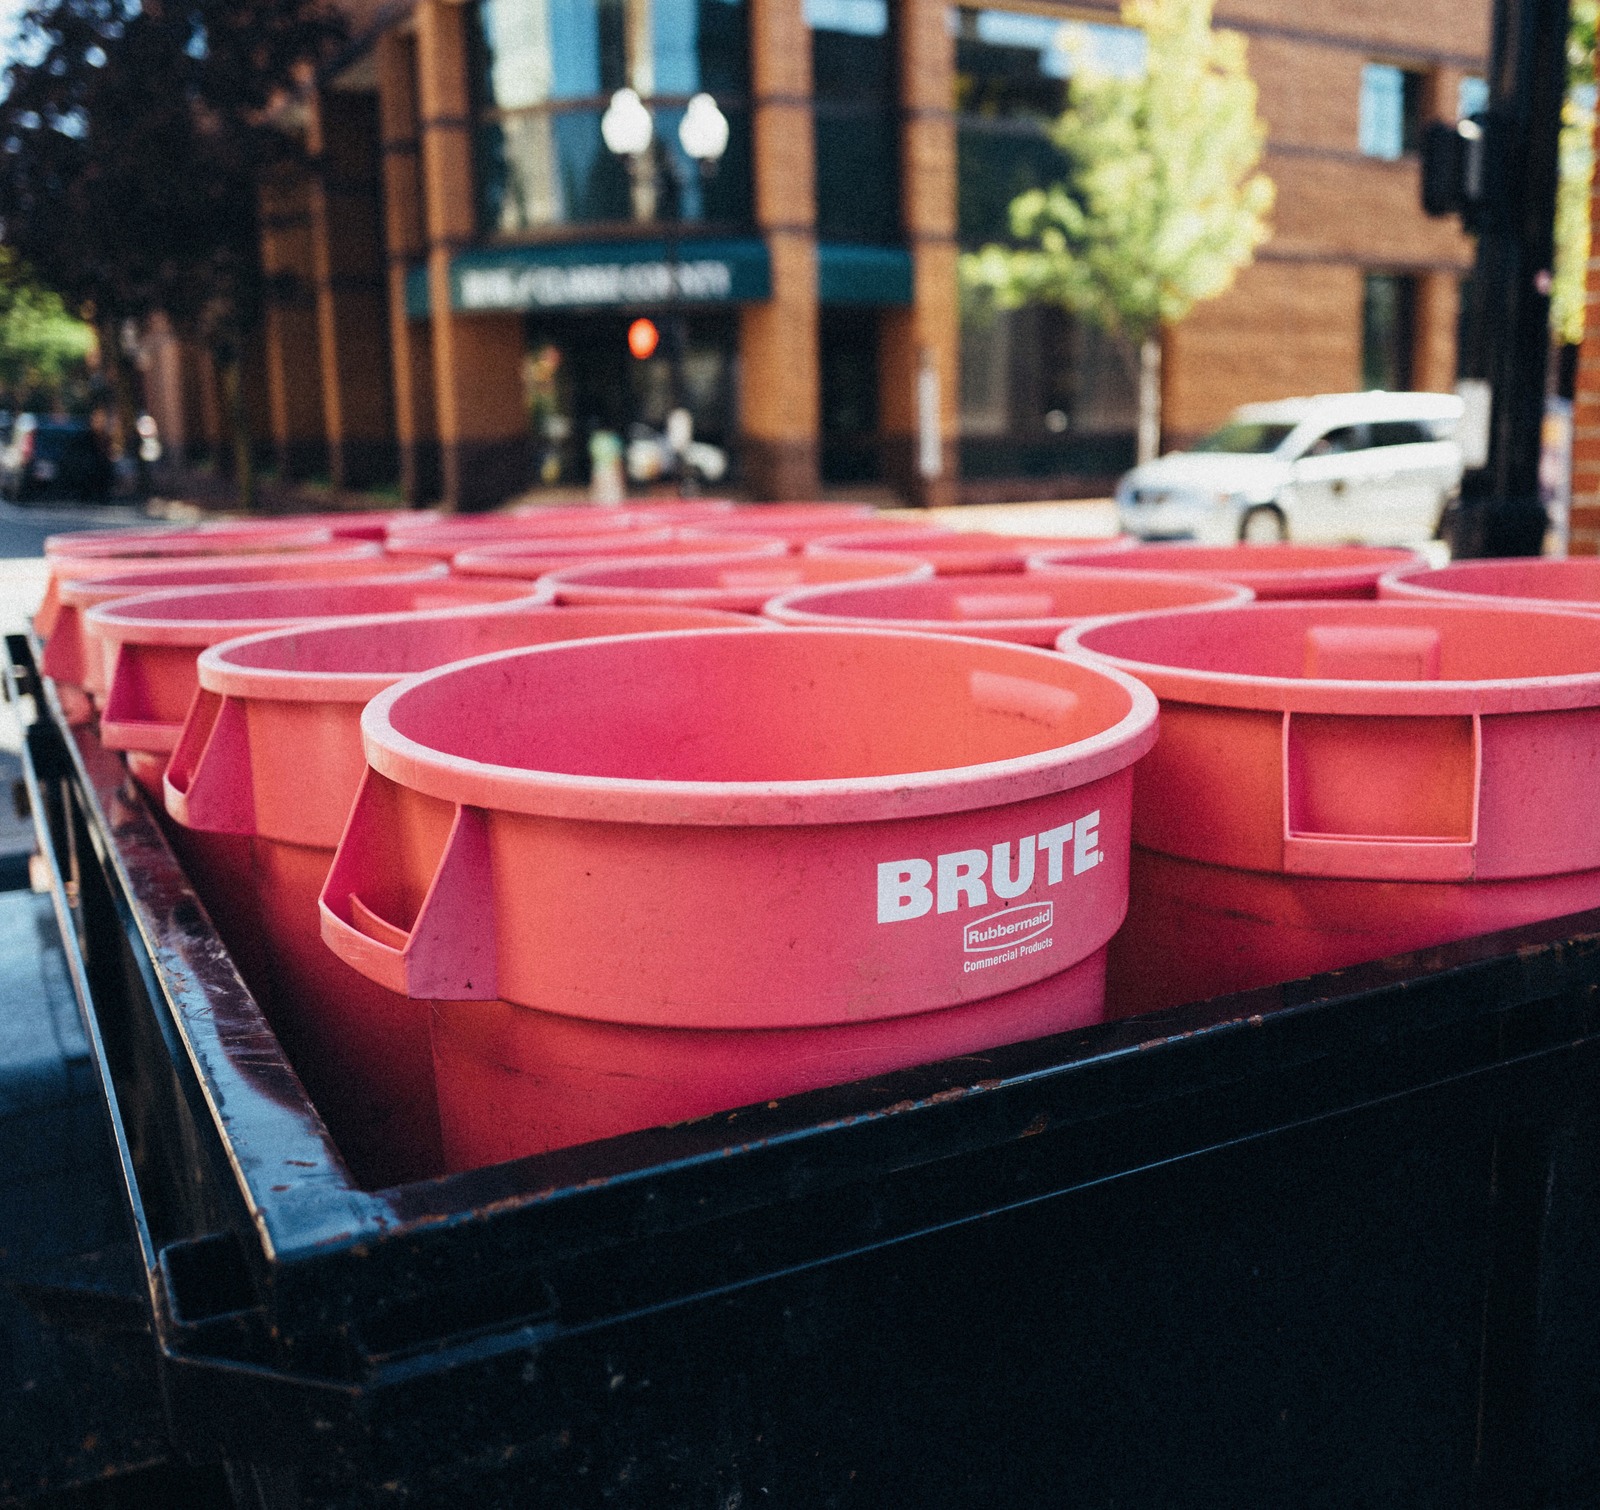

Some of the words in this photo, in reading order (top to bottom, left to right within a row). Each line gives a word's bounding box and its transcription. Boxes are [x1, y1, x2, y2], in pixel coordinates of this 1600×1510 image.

[968, 909, 1050, 945] Rubbermaid
[963, 948, 1018, 973] Commercial
[1020, 937, 1053, 957] Products
